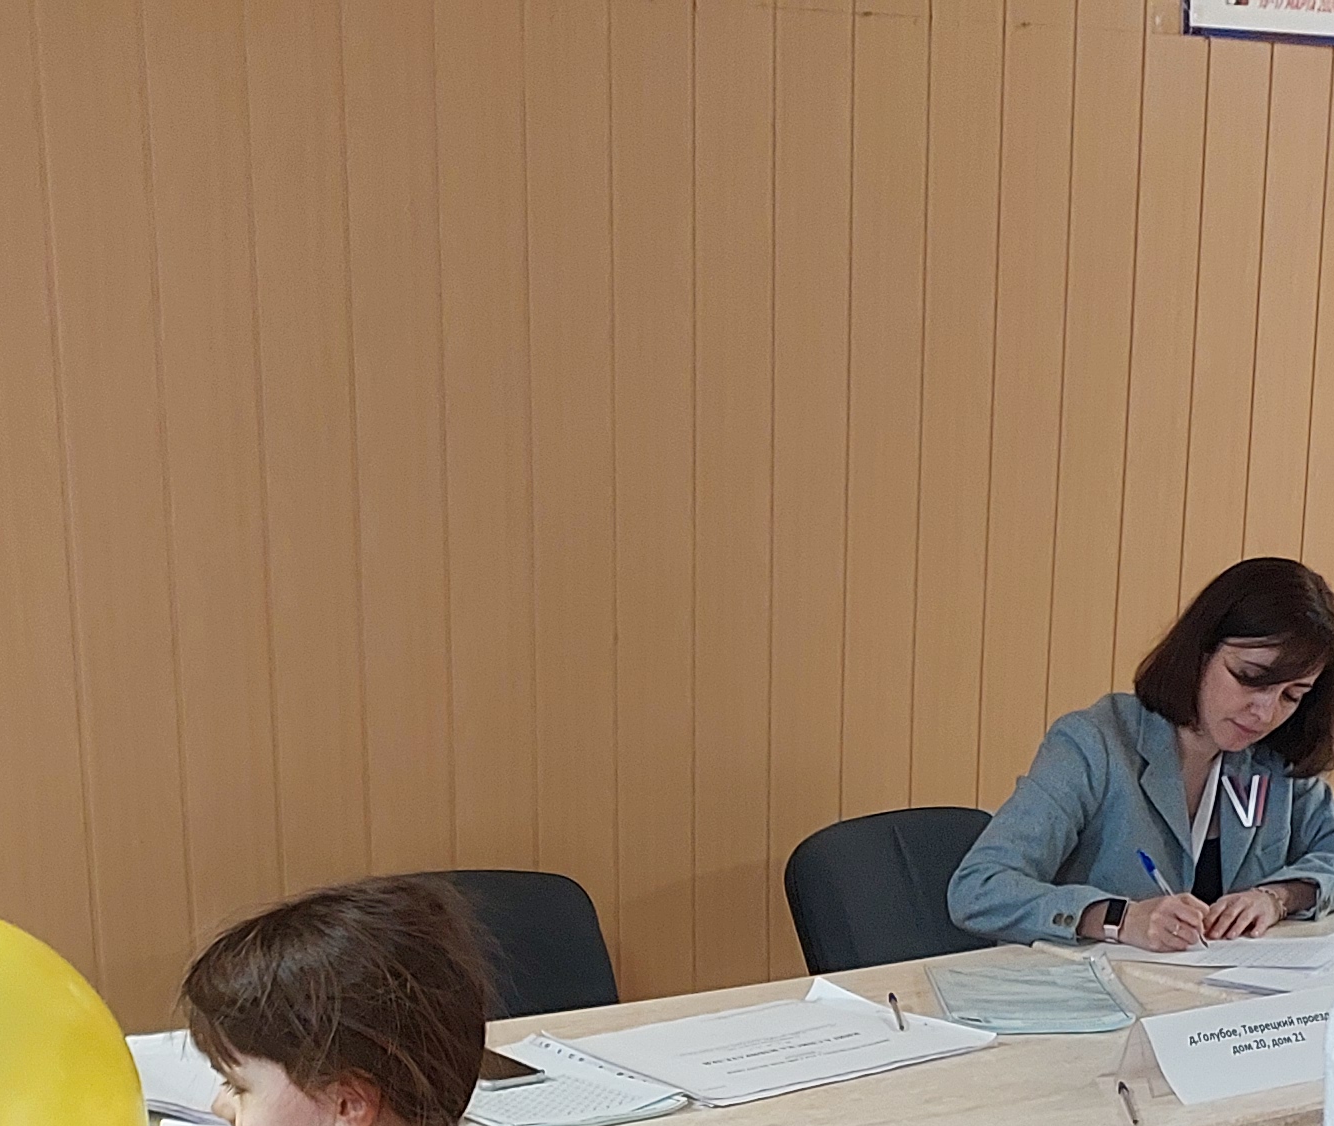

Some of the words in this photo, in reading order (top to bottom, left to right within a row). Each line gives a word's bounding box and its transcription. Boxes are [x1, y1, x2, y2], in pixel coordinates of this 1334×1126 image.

[1241, 1016, 1294, 1034] Тверецкий
[1233, 1043, 1253, 1055] дом
[1253, 1039, 1271, 1049] 20,
[1272, 1036, 1292, 1048] дом
[1292, 1032, 1306, 1042] 21
